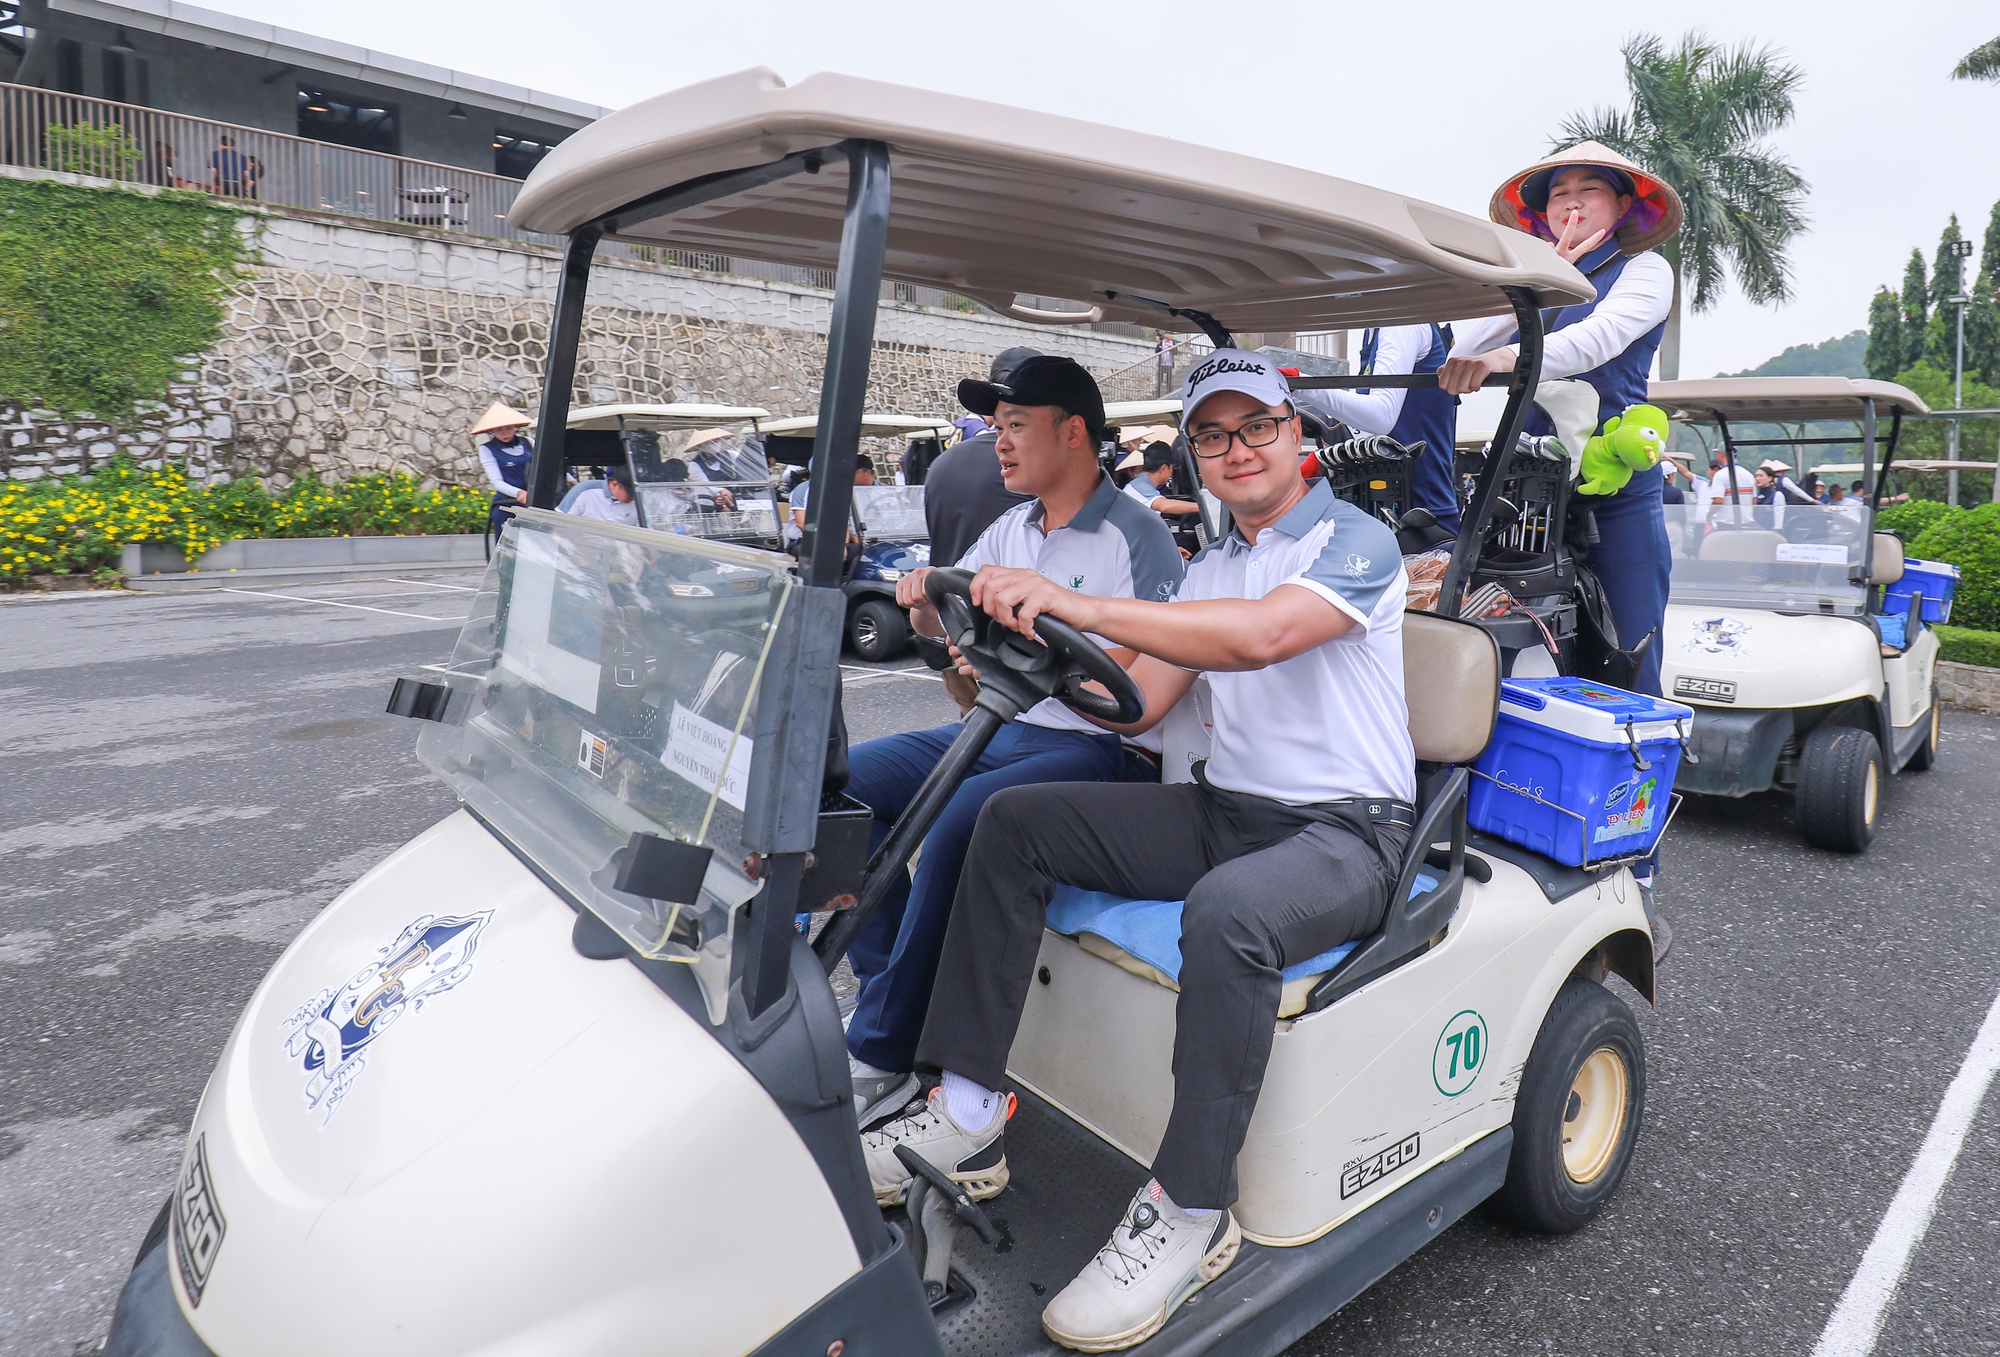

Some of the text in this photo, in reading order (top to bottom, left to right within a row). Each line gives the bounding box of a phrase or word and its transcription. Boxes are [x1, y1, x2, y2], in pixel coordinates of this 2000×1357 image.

[1187, 358, 1266, 398] Titleist
[1676, 678, 1735, 696] EZGO
[1446, 1025, 1480, 1080] 70
[1342, 1133, 1420, 1199] EZGO
[1343, 1154, 1363, 1170] RXV
